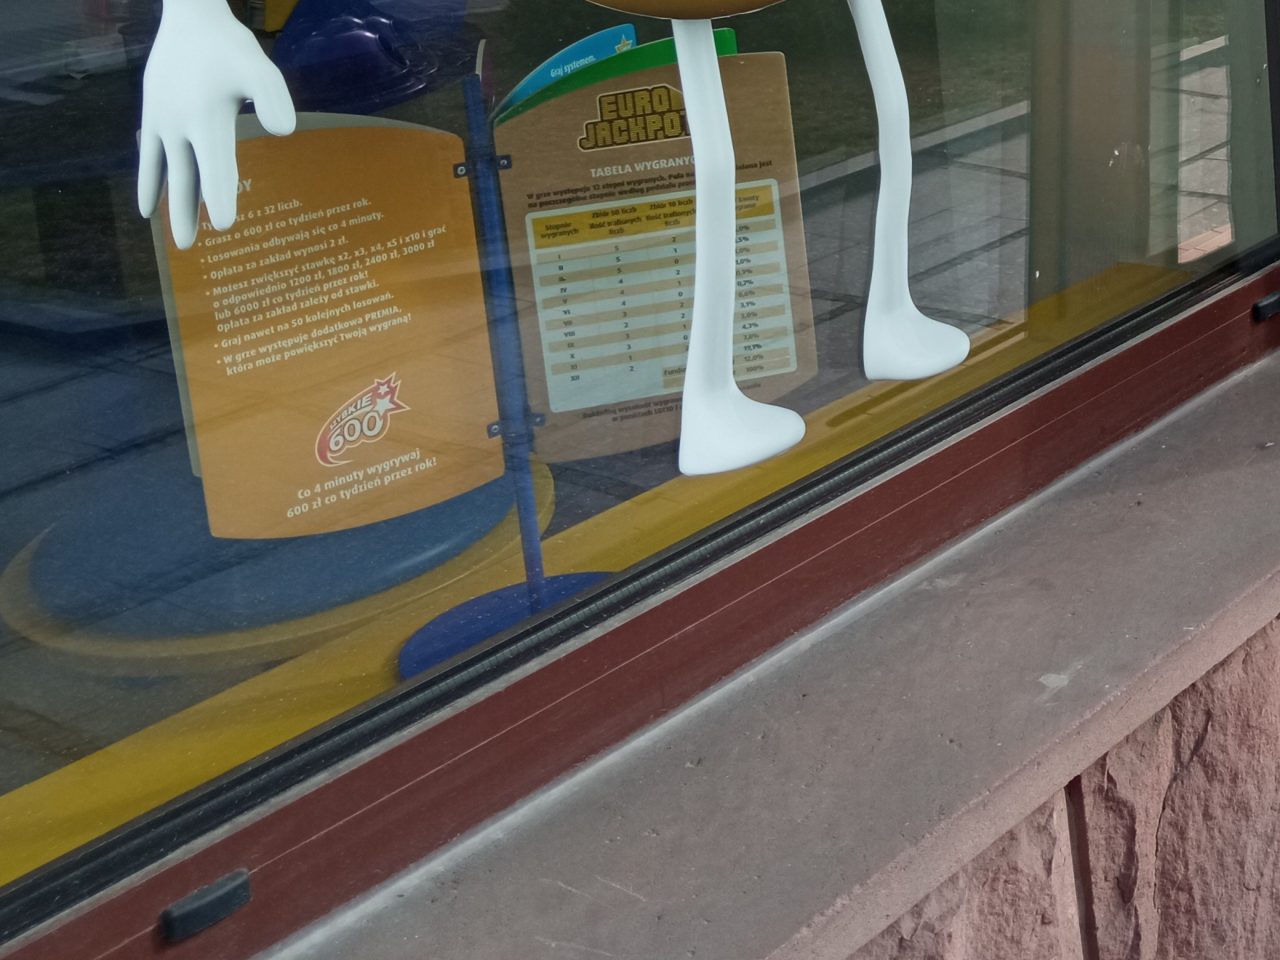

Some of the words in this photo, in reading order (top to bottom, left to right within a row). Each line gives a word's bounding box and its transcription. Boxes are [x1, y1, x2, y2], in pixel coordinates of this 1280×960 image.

[599, 87, 670, 121] EURO
[579, 111, 690, 151] JACKPO
[590, 162, 632, 178] TABELA
[633, 155, 696, 172] WYGRANYC
[205, 234, 232, 246] Grasz
[243, 225, 262, 237] 600
[265, 222, 273, 231] zł
[275, 220, 286, 228] co
[288, 209, 324, 226] tydzień
[326, 203, 351, 217] przez
[353, 197, 372, 208] rok.
[248, 210, 254, 218] 6
[264, 205, 275, 214] 32
[277, 198, 303, 211] liczb.
[207, 243, 260, 263] Losowania
[262, 229, 310, 248] odbywają
[312, 225, 326, 235] się
[328, 223, 338, 231] co
[340, 219, 347, 228] 4
[348, 211, 384, 226] minuty.
[210, 264, 243, 279] Opłata
[245, 261, 257, 270] za
[259, 250, 292, 266] zakład
[293, 240, 328, 256] wynosi
[330, 239, 335, 247] 2
[338, 235, 349, 245] zł.
[213, 280, 248, 296] Możesz
[251, 264, 299, 285] zwiększyć
[301, 257, 336, 271] stawkę
[337, 251, 352, 261] x2,
[354, 247, 368, 257] x3,
[370, 242, 384, 252] x4,
[386, 238, 397, 248] x5
[405, 232, 420, 243] x10
[427, 223, 446, 238] grać
[215, 308, 231, 320] lub
[233, 301, 259, 315] 6000
[262, 297, 270, 307] zł
[272, 295, 283, 304] co
[285, 283, 321, 301] tydzień
[323, 277, 348, 292] przez
[349, 270, 369, 282] rok!
[222, 282, 287, 305] odpowiednio
[289, 274, 311, 287] 1200
[314, 270, 325, 280] zł,
[327, 263, 350, 276] 1800
[352, 260, 363, 270] zł,
[366, 253, 388, 266] 2400
[389, 249, 401, 260] zł,
[402, 243, 425, 256] 3000
[427, 239, 435, 249] zł
[217, 317, 250, 332] Opłata
[252, 313, 263, 322] za
[265, 302, 298, 318] zakład
[299, 294, 329, 309] zależy
[331, 288, 343, 299] od
[345, 278, 380, 296] stawki.
[221, 334, 241, 348] Graj
[243, 325, 275, 341] nawet
[277, 323, 289, 332] na
[291, 317, 303, 328] 50
[305, 303, 351, 322] kolejnych
[352, 291, 394, 309] losowań.
[223, 354, 233, 364] W
[235, 349, 256, 362] grze
[258, 333, 309, 353] występuje
[311, 317, 363, 338] dodatkowa
[364, 305, 402, 322] PREMIA,
[226, 362, 253, 376] która
[255, 354, 282, 367] może
[283, 335, 338, 360] powiększyć
[339, 327, 367, 341] Twoją
[368, 312, 412, 332] wygraną!
[329, 410, 384, 451] 600
[287, 503, 309, 518] 600
[312, 497, 322, 510] zł
[325, 494, 337, 505] co
[339, 476, 381, 500] tydzień
[384, 467, 412, 486] przez
[415, 456, 437, 472] rok!
[297, 488, 311, 499] Co
[314, 483, 321, 493] 4
[324, 470, 364, 490] minuty
[367, 447, 421, 474] wygrywaj
